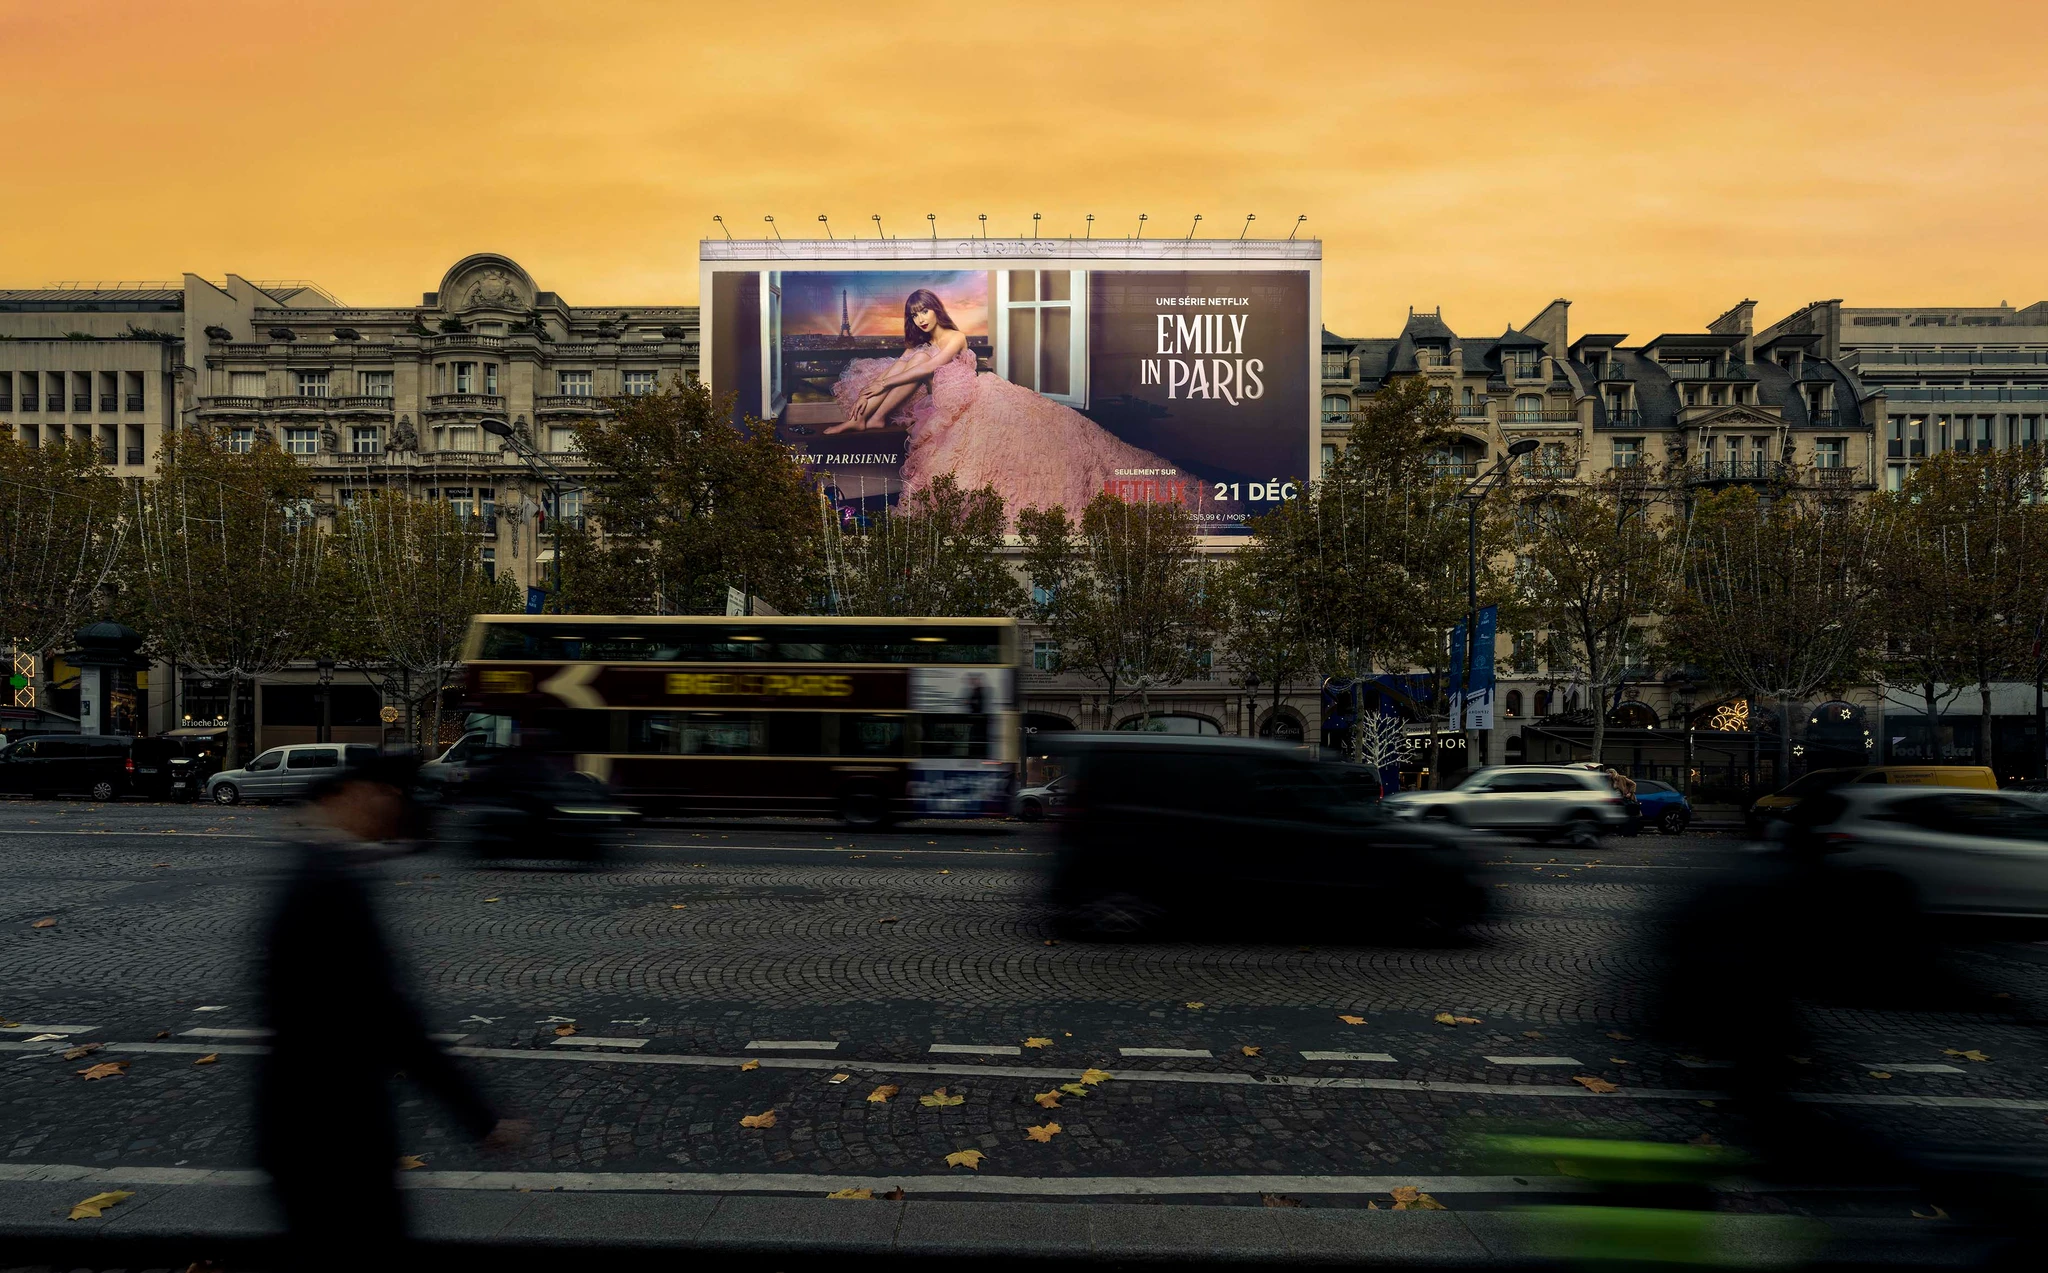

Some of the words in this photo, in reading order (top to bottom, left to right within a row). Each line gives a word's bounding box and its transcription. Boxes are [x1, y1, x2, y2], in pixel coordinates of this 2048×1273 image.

[1156, 297, 1177, 306] UNE
[1178, 295, 1206, 306] SÉRIE
[1207, 297, 1249, 306] NETFLIX
[1156, 314, 1249, 354] EMILY
[1140, 359, 1161, 385] IN
[1167, 358, 1265, 406] PARIS
[825, 453, 898, 464] PARISIENNE
[1114, 468, 1161, 476] SEULEMENT
[1161, 468, 1177, 476] SUR
[1103, 480, 1188, 504] NETFLIX
[1214, 482, 1240, 501] 21
[1226, 513, 1246, 522] MOIS
[182, 719, 212, 728] Brioche
[213, 719, 228, 728] Dor
[1405, 738, 1467, 749] SEPHOR
